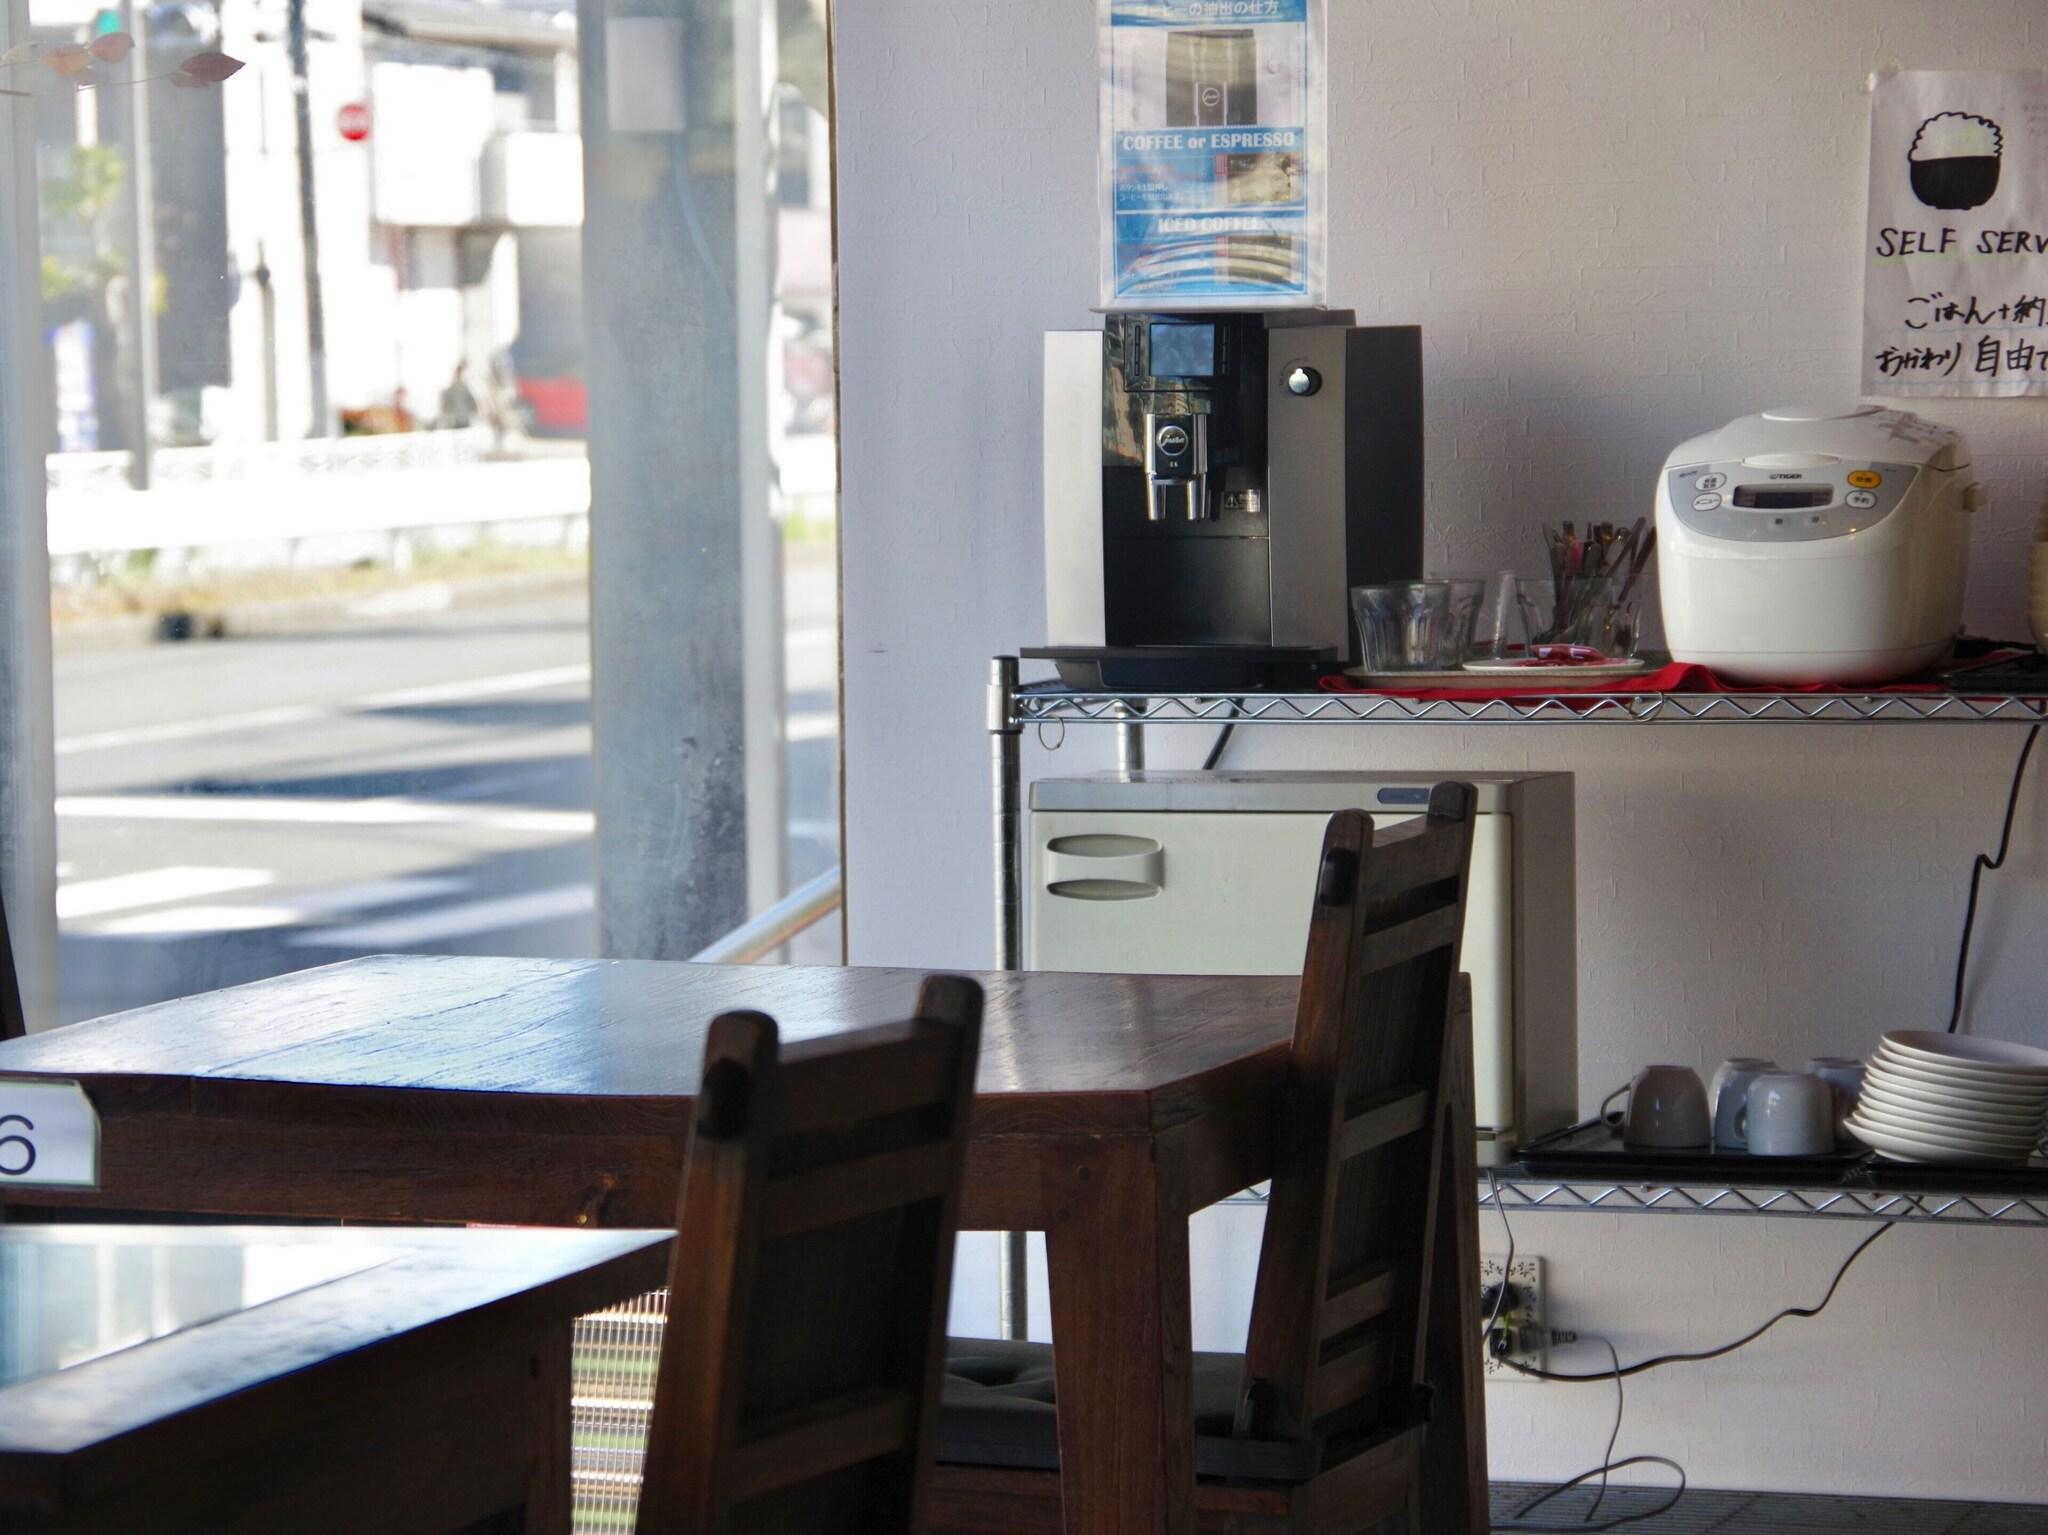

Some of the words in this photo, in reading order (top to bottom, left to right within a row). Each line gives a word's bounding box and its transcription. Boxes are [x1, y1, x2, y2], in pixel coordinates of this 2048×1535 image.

[1122, 134, 1184, 151] COFFEE
[1188, 136, 1207, 149] or
[1211, 131, 1295, 148] ESPRESSO
[1875, 227, 1957, 258] SELF
[1904, 291, 2048, 329] ごはん+納
[0, 1113, 37, 1176] 6
